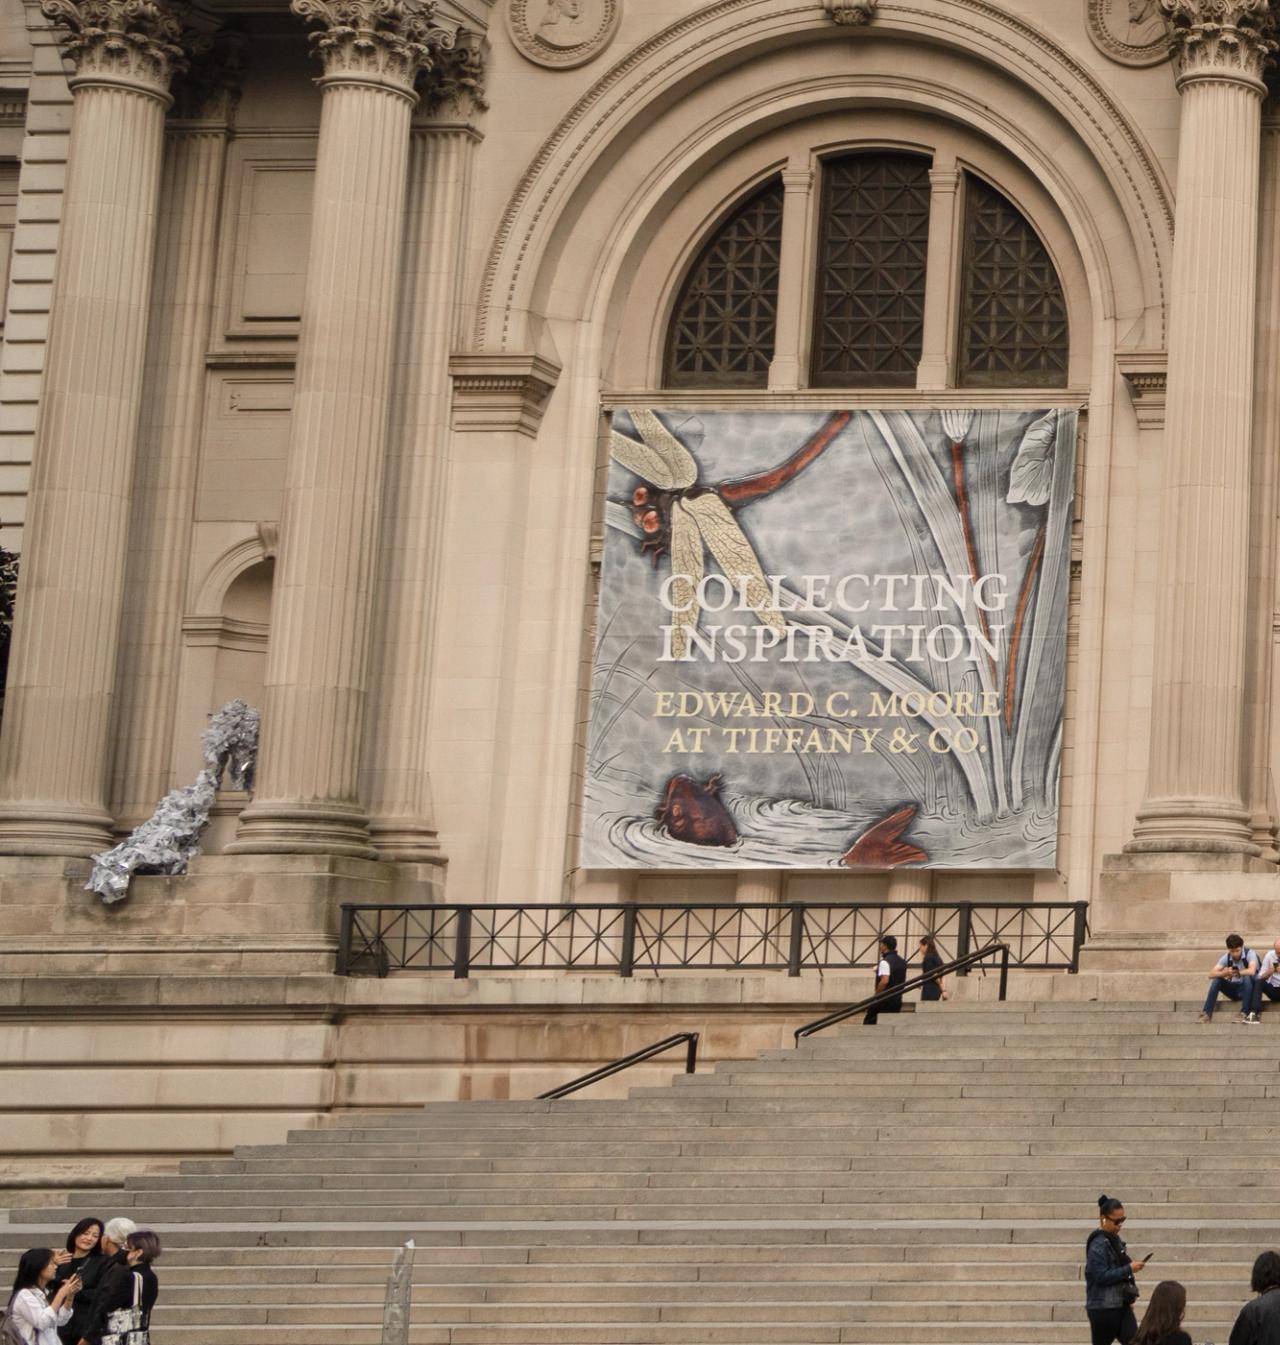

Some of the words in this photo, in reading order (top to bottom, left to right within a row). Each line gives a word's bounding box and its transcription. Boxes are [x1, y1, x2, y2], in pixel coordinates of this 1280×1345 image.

[658, 573, 1008, 612] COLLECTING
[655, 623, 1006, 662] INSPIRATION
[653, 691, 815, 718] EDWARD
[826, 691, 858, 718] C.
[870, 691, 1002, 718] MOORE
[661, 727, 712, 754] AT
[722, 727, 884, 754] TIFFANY
[888, 728, 919, 754] &
[928, 727, 989, 754] CO.
